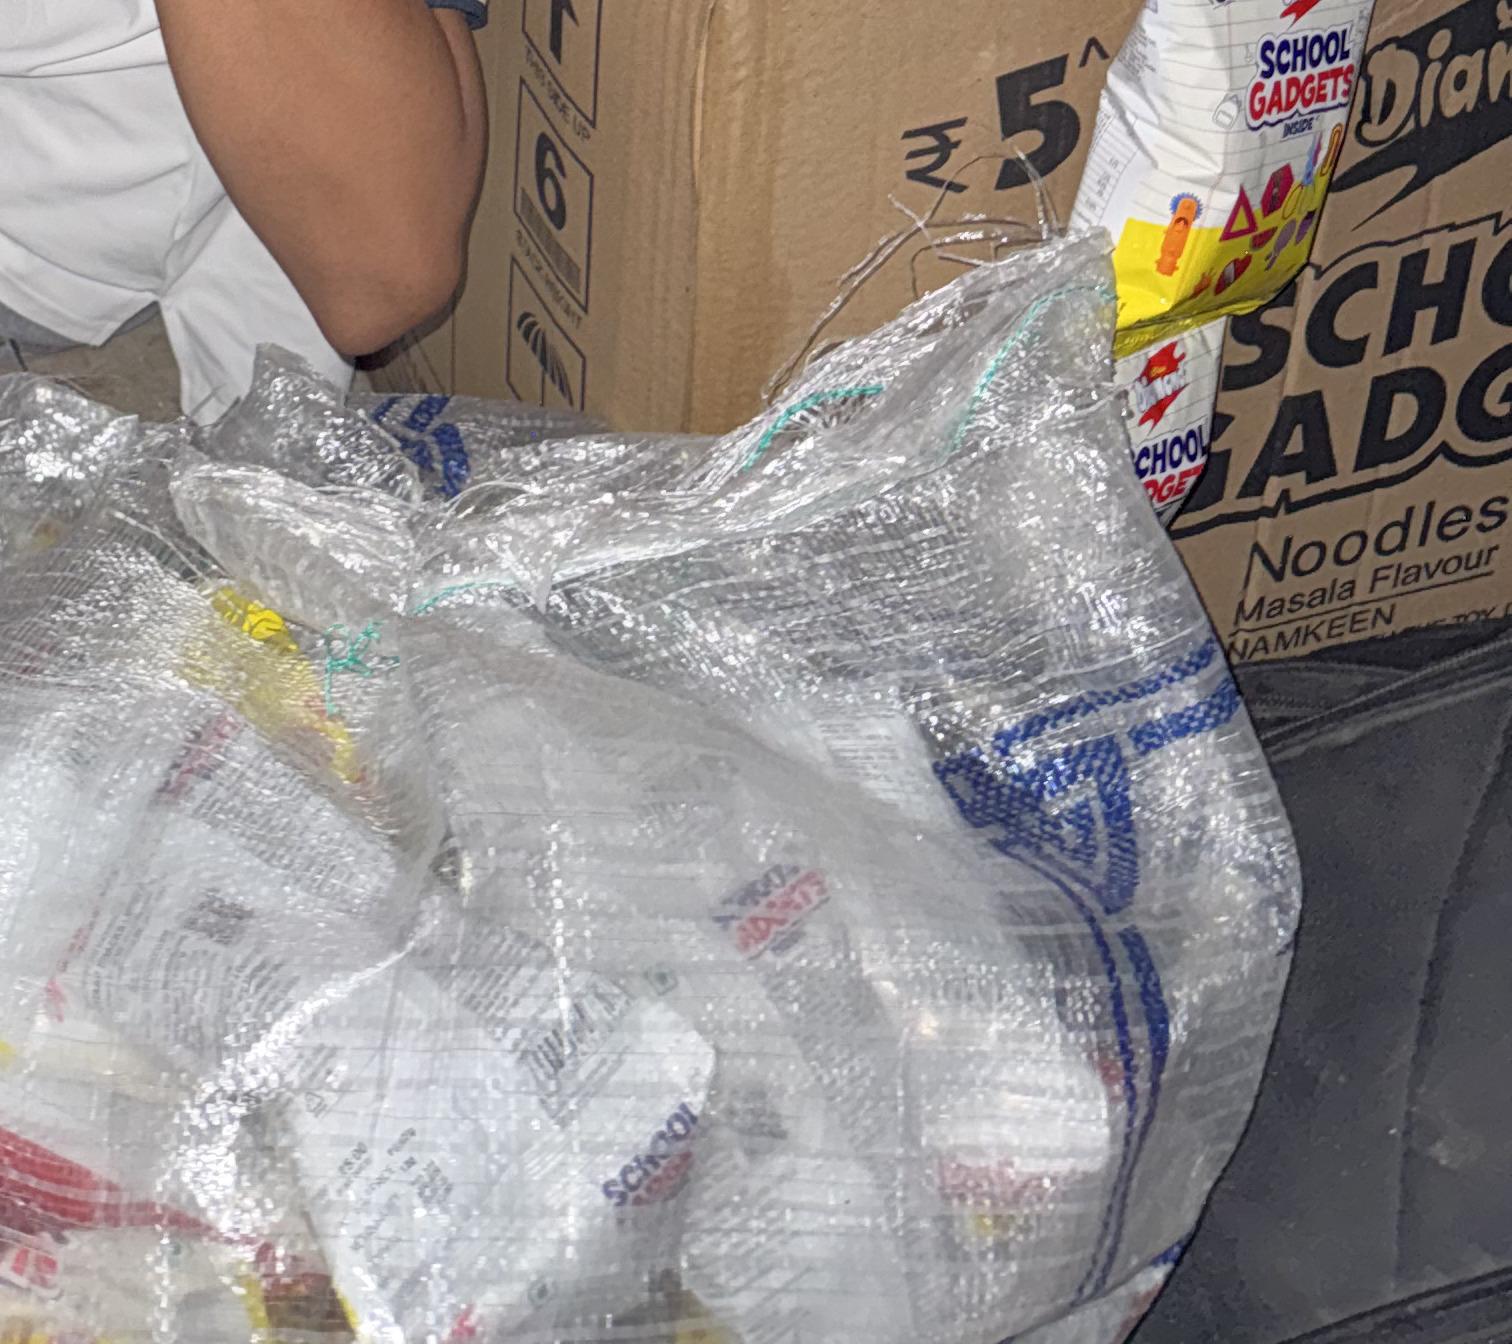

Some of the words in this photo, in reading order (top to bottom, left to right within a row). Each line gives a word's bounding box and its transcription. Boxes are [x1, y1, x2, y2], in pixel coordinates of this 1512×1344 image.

[1260, 27, 1350, 79] SCHOOL
[1248, 64, 1355, 120] GADGETS
[1282, 115, 1315, 136] INSIDE
[535, 131, 566, 230] 6
[1130, 425, 1209, 479] CHOOL
[1243, 495, 1510, 590] Noodles
[1233, 578, 1356, 628] Masala
[1369, 544, 1499, 593] Flavour
[1226, 603, 1396, 660] NAMKEEN
